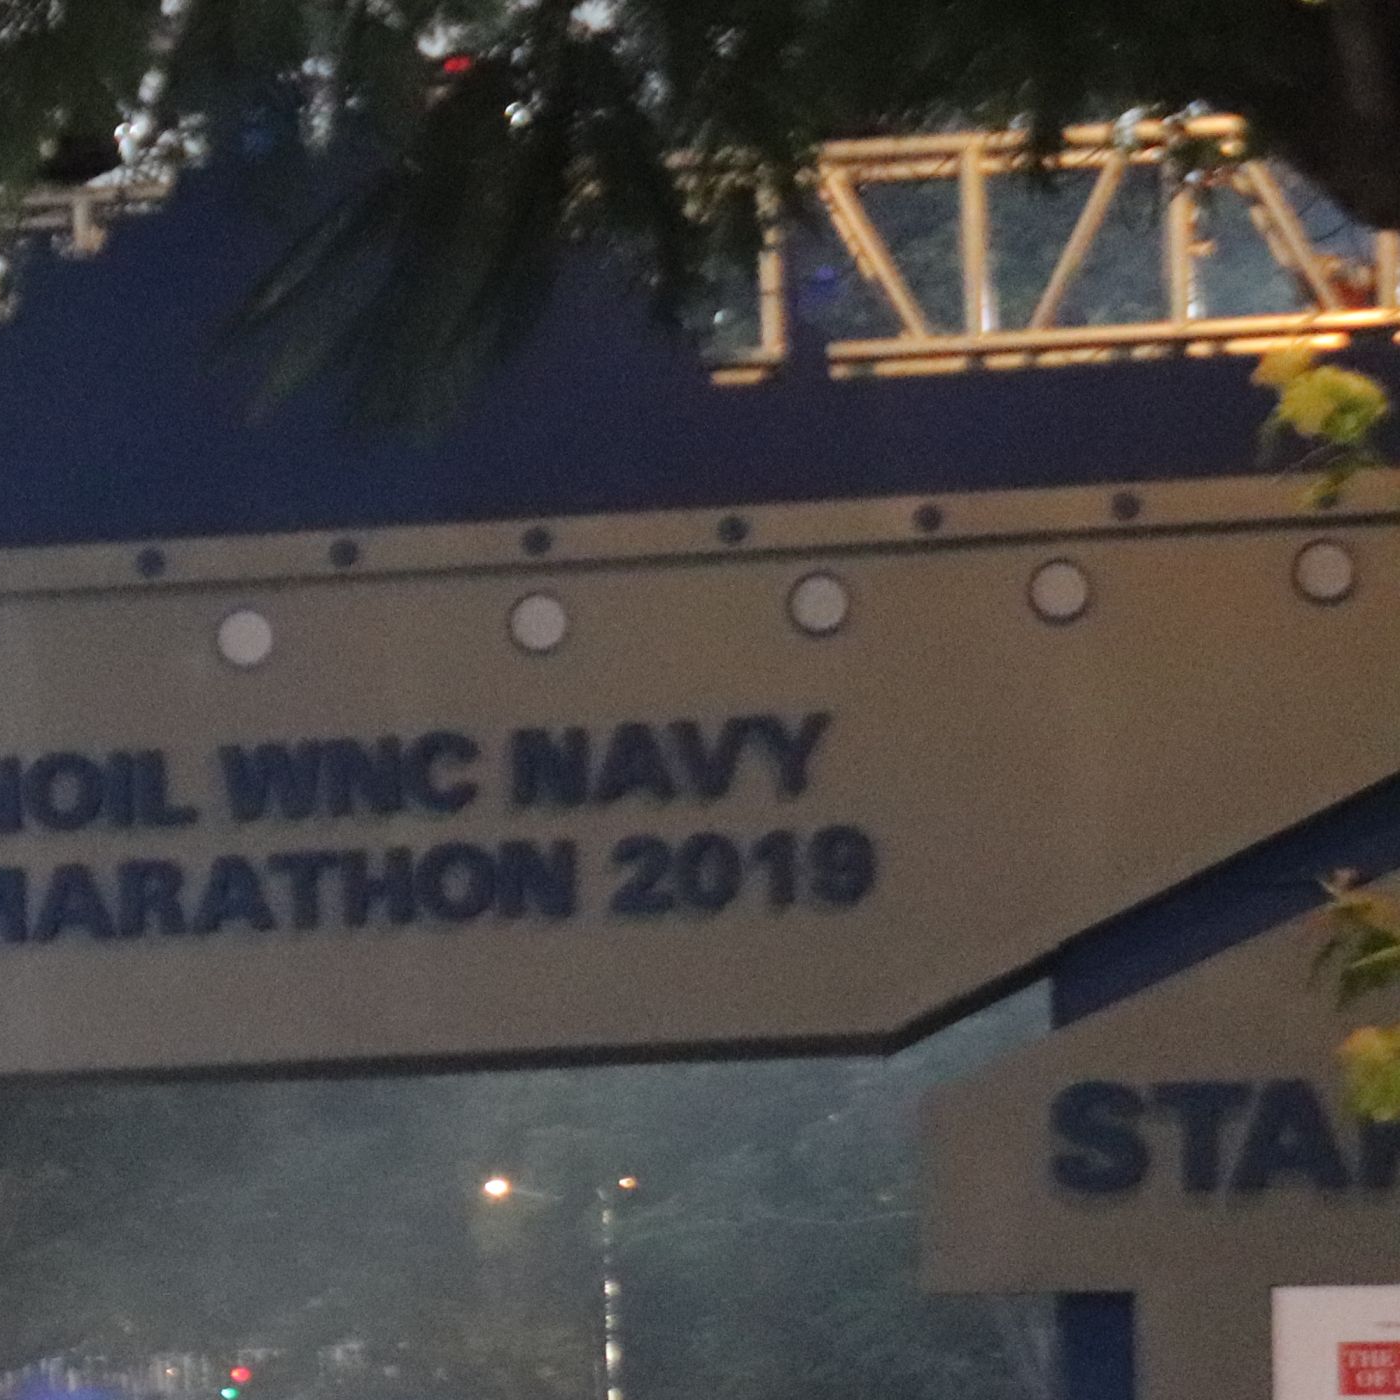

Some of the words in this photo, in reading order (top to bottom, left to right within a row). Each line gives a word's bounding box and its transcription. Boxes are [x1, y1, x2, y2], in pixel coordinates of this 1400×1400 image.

[218, 730, 480, 823] WNC
[510, 710, 835, 806] NAVY
[610, 823, 878, 919] 2019
